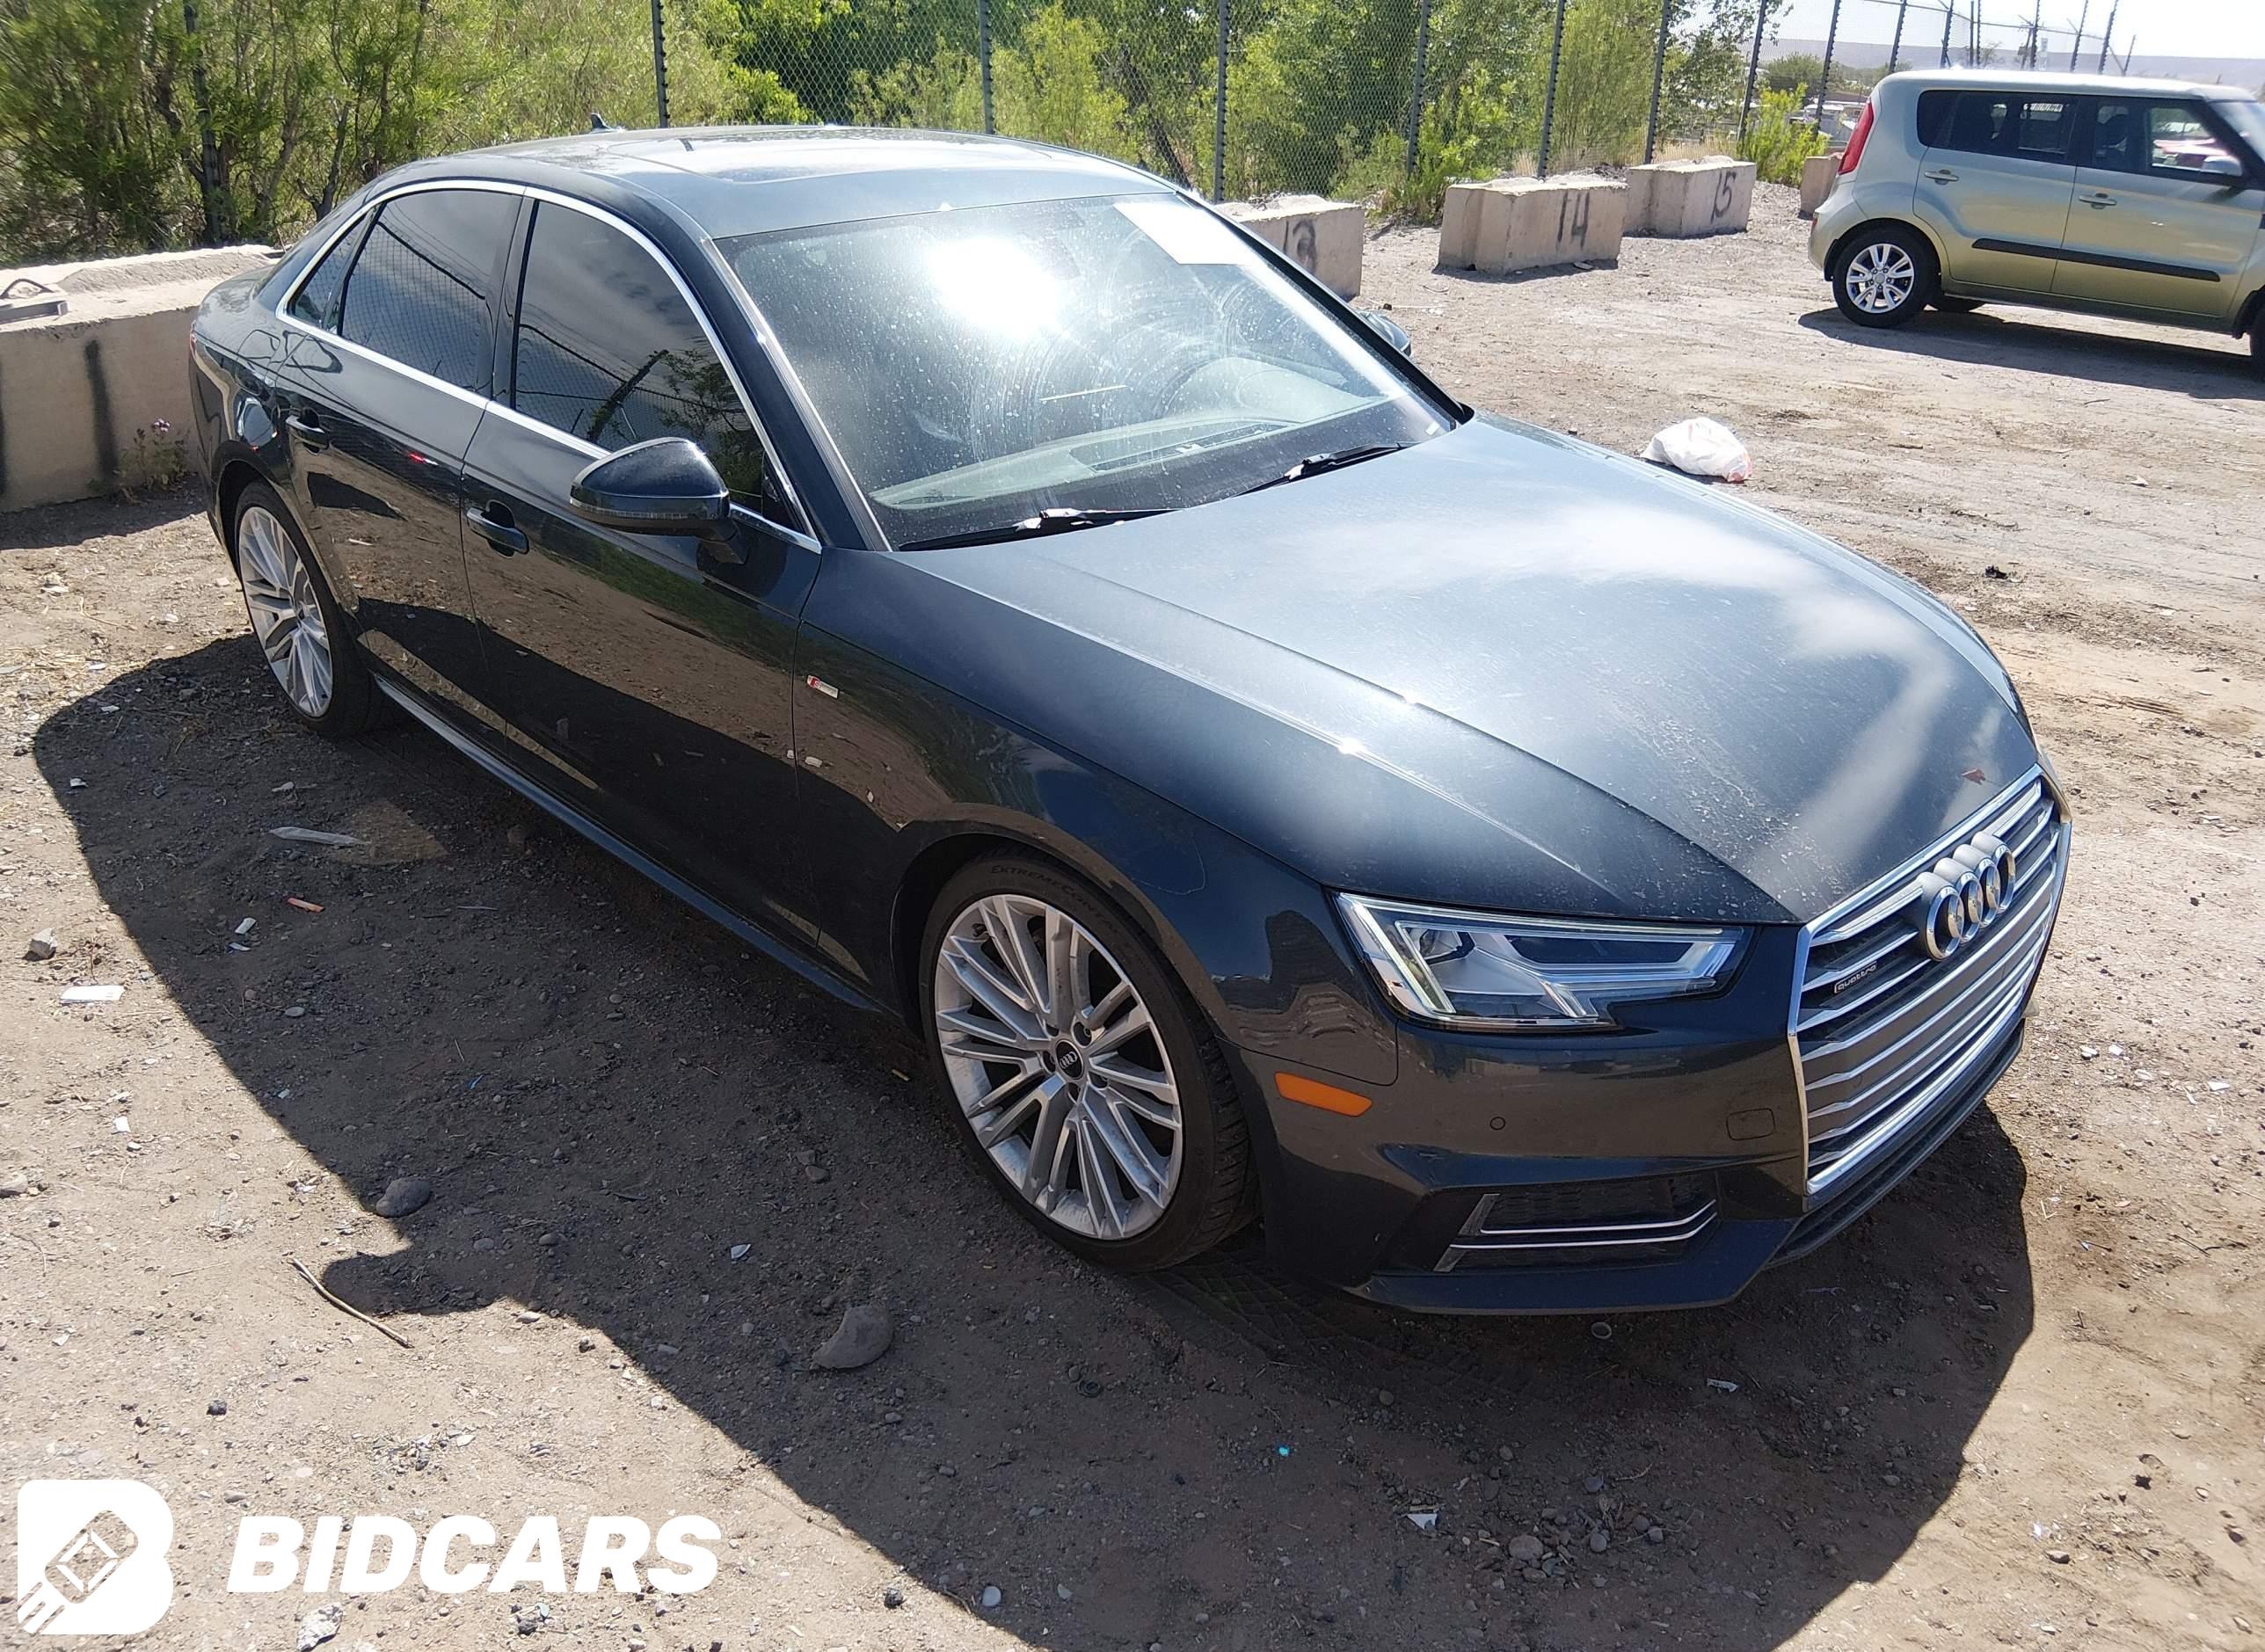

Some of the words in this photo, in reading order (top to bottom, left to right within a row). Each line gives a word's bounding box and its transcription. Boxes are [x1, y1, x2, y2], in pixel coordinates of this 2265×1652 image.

[1555, 191, 1591, 250] 14
[1710, 171, 1737, 224] 15
[1835, 963, 1877, 993] quattro
